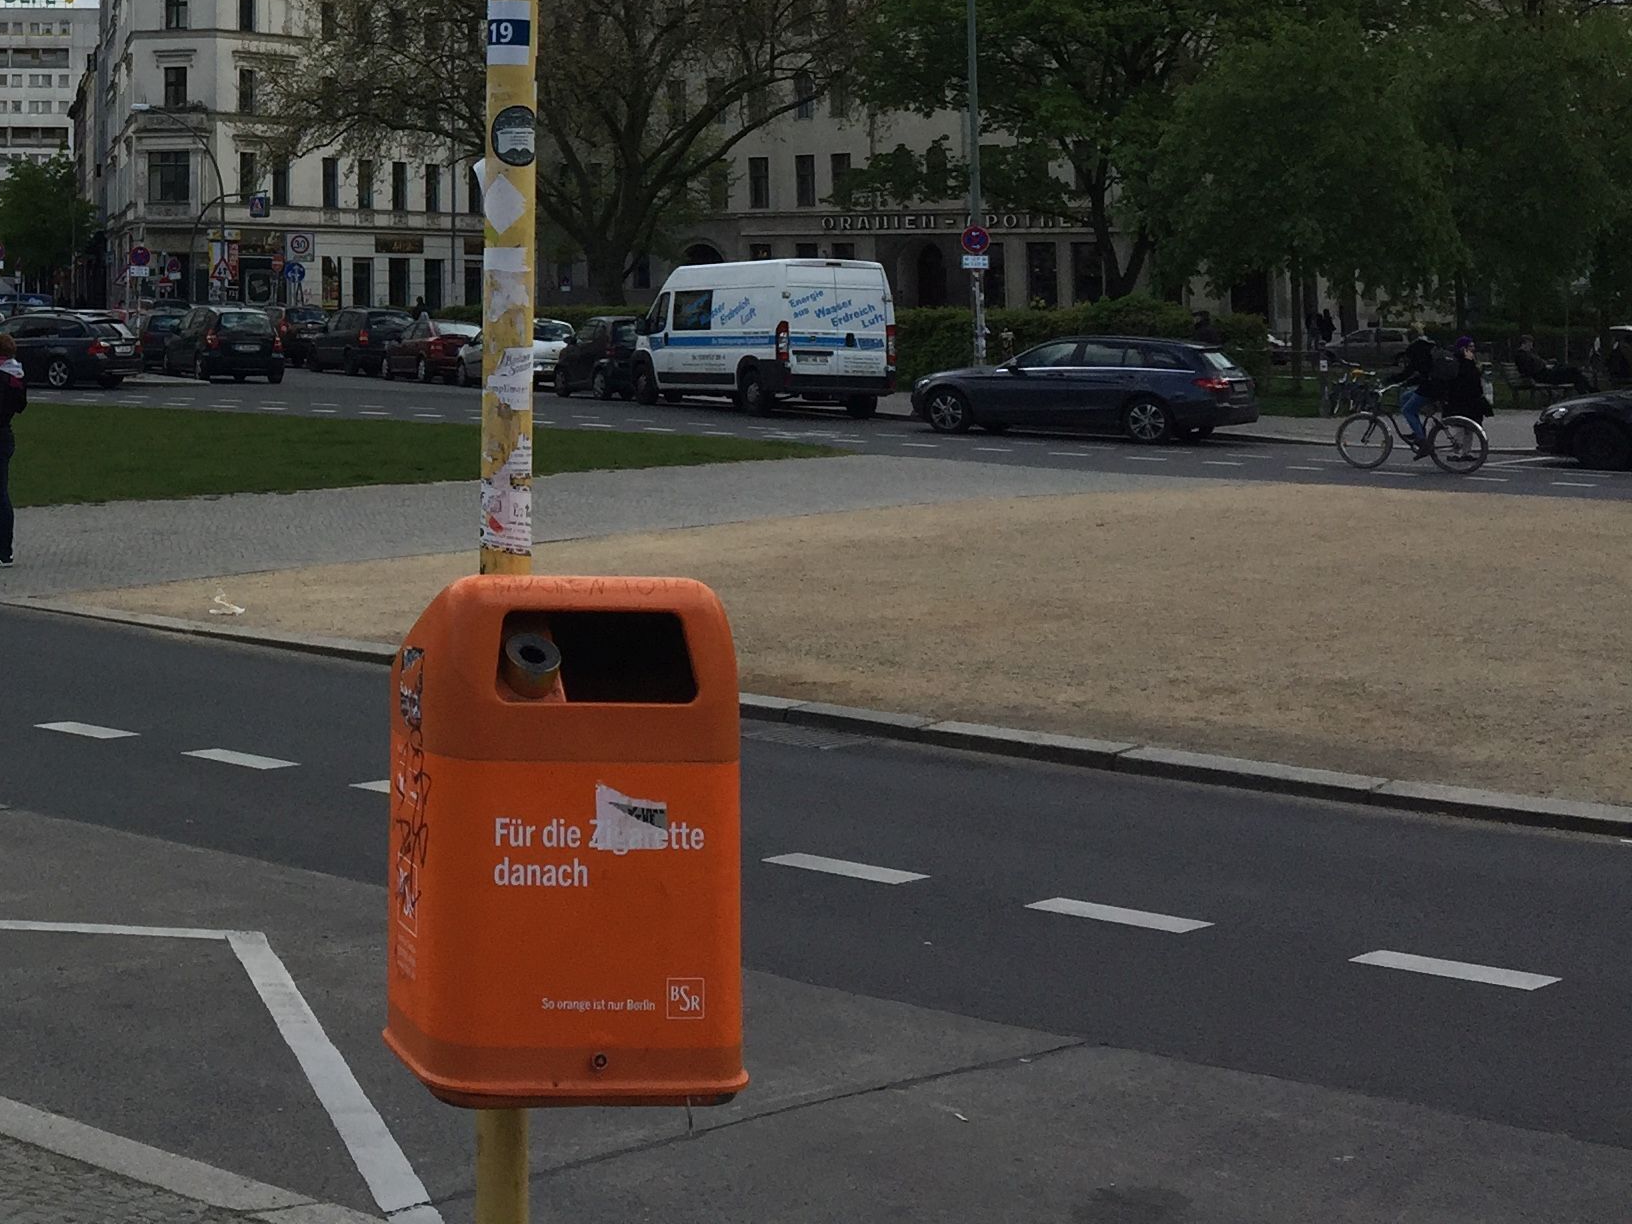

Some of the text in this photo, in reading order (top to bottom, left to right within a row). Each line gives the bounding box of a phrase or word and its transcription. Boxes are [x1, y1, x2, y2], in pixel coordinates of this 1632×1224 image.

[489, 21, 513, 43] 19
[789, 290, 824, 307] Energie
[793, 298, 852, 319] aus Wasser
[831, 304, 876, 327] Erdreich
[861, 313, 885, 329] Luft
[495, 817, 536, 848] Für
[542, 818, 581, 849] die
[494, 857, 588, 887] danach
[541, 997, 656, 1013] So orange ist nur Berlin
[670, 985, 701, 1011] BSR
